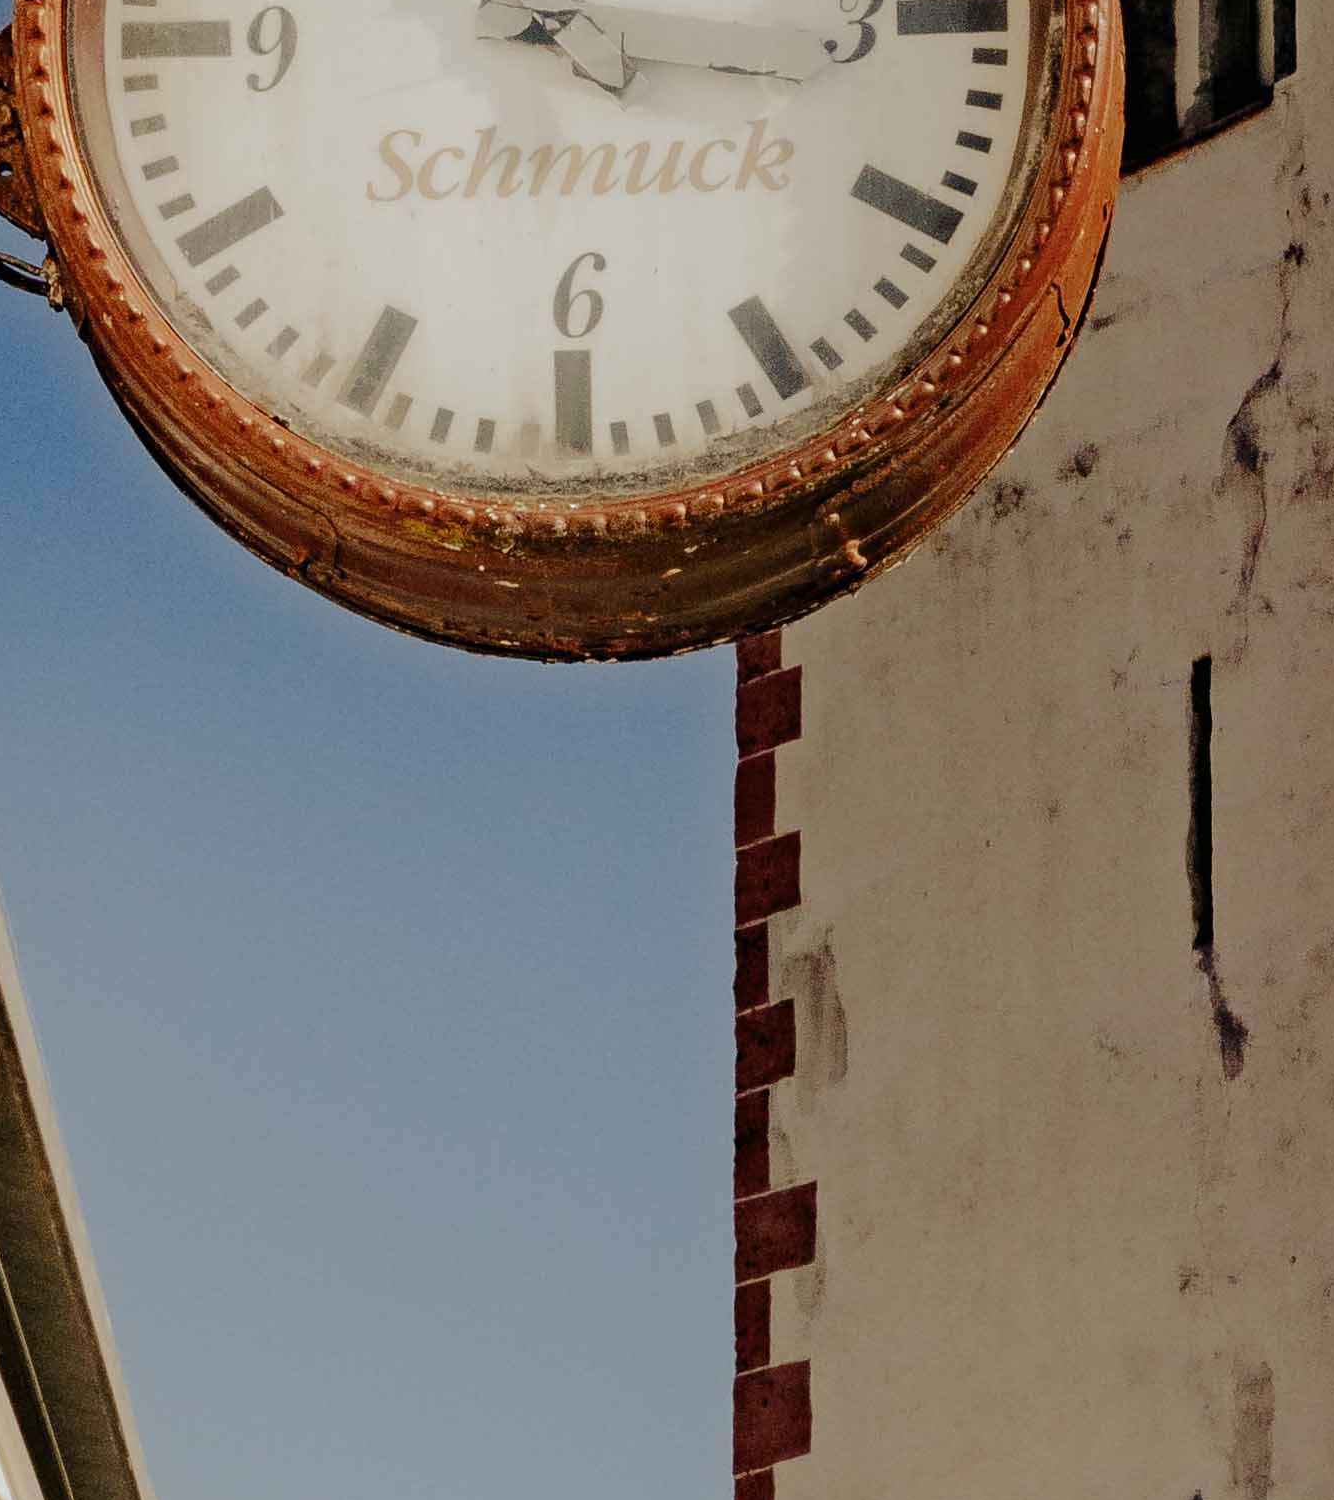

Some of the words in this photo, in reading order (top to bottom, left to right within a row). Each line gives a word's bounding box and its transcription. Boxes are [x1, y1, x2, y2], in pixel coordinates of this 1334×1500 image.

[246, 5, 298, 92] 9
[366, 118, 796, 201] Schmuck
[552, 251, 606, 338] 6
